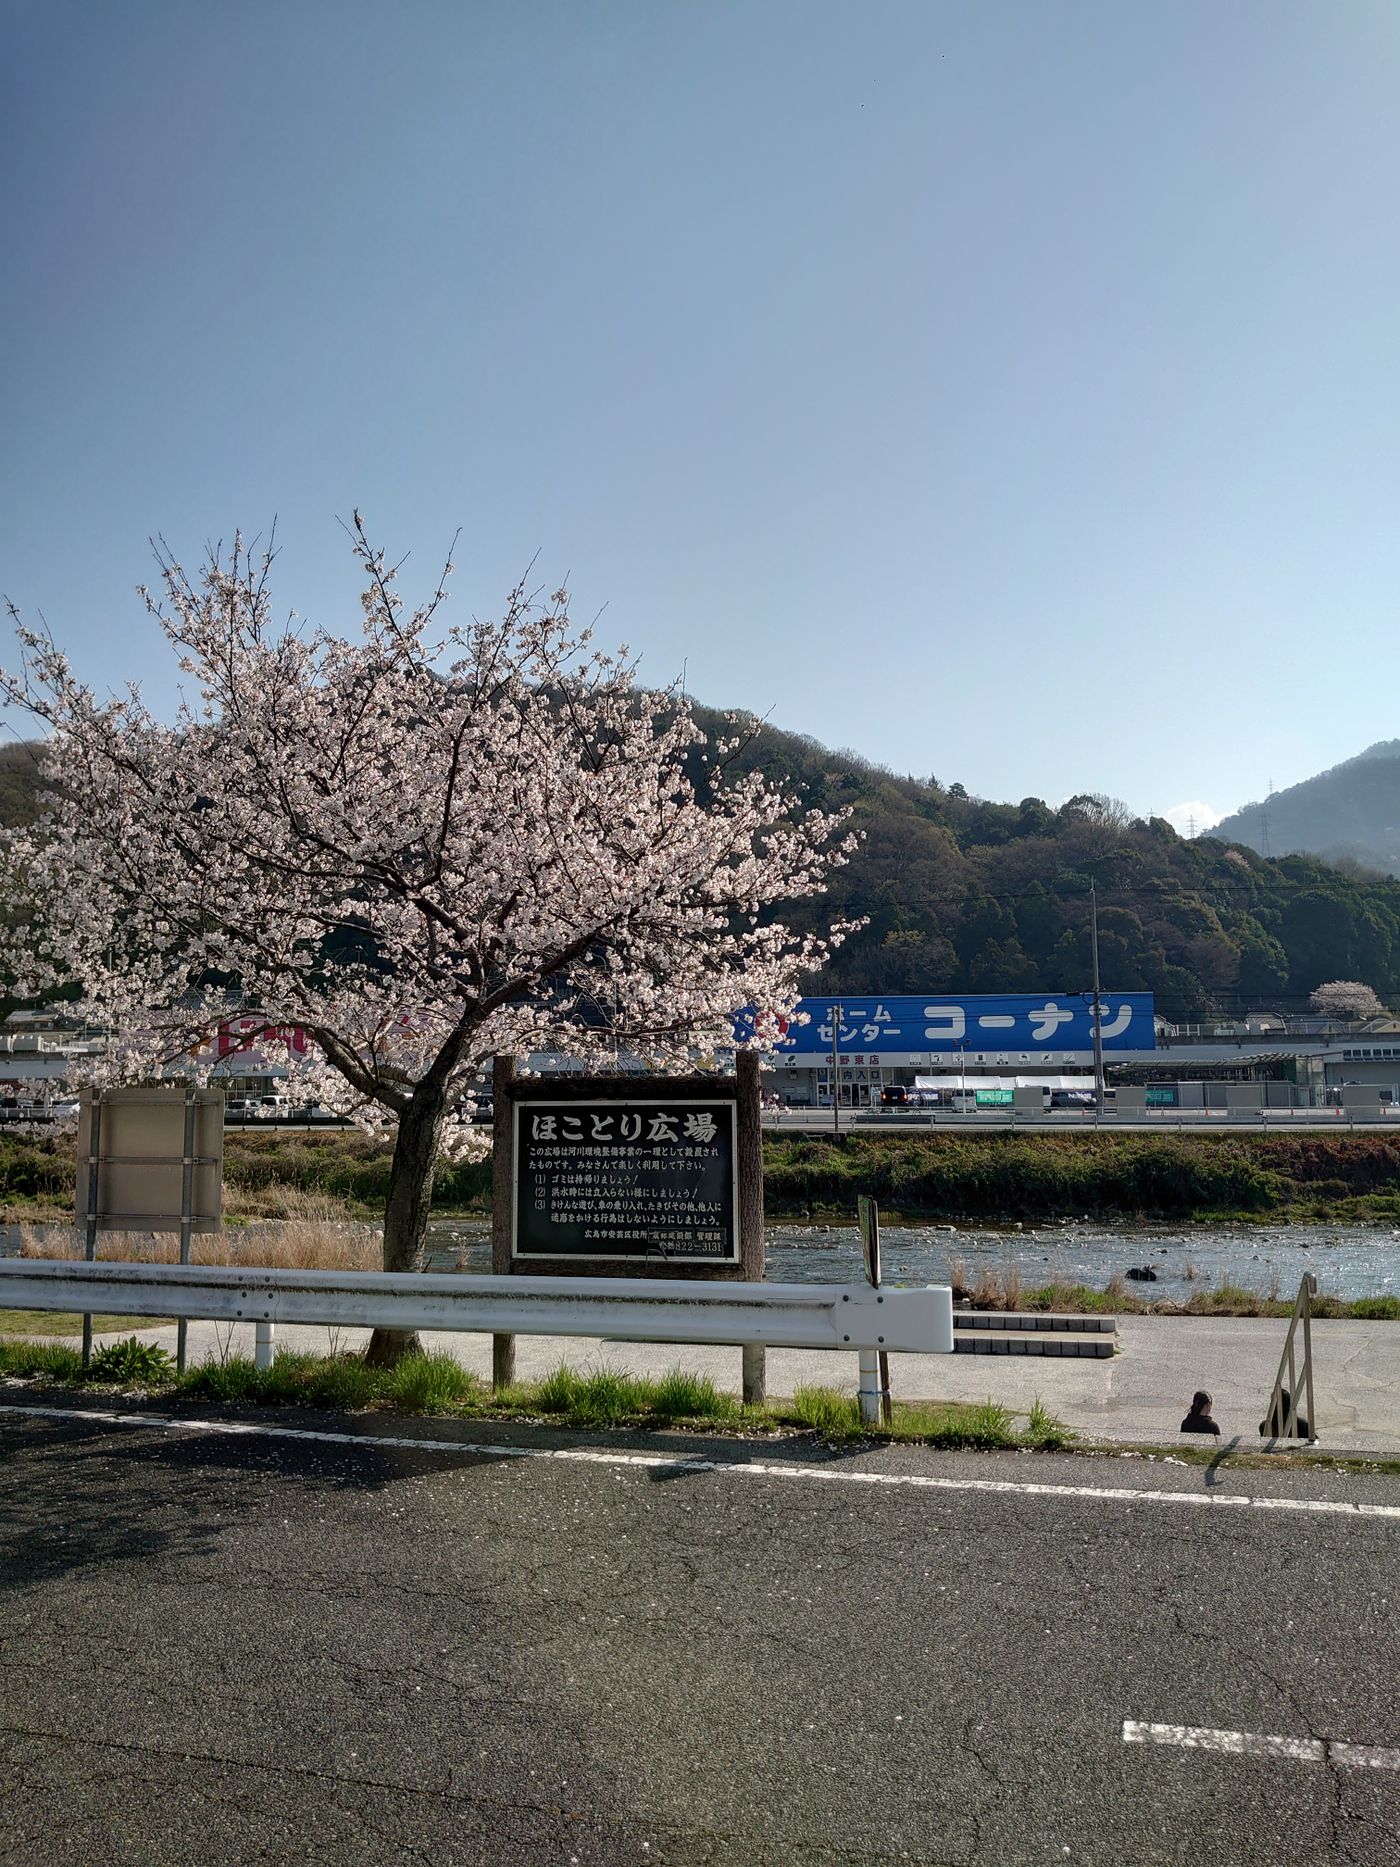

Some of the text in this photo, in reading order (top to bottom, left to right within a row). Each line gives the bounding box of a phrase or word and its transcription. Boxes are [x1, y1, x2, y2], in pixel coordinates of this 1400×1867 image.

[816, 1023, 901, 1042] センター
[923, 1002, 1133, 1041] コーナン
[825, 1054, 880, 1065] 中野東店
[531, 1112, 719, 1143] ほことり広場
